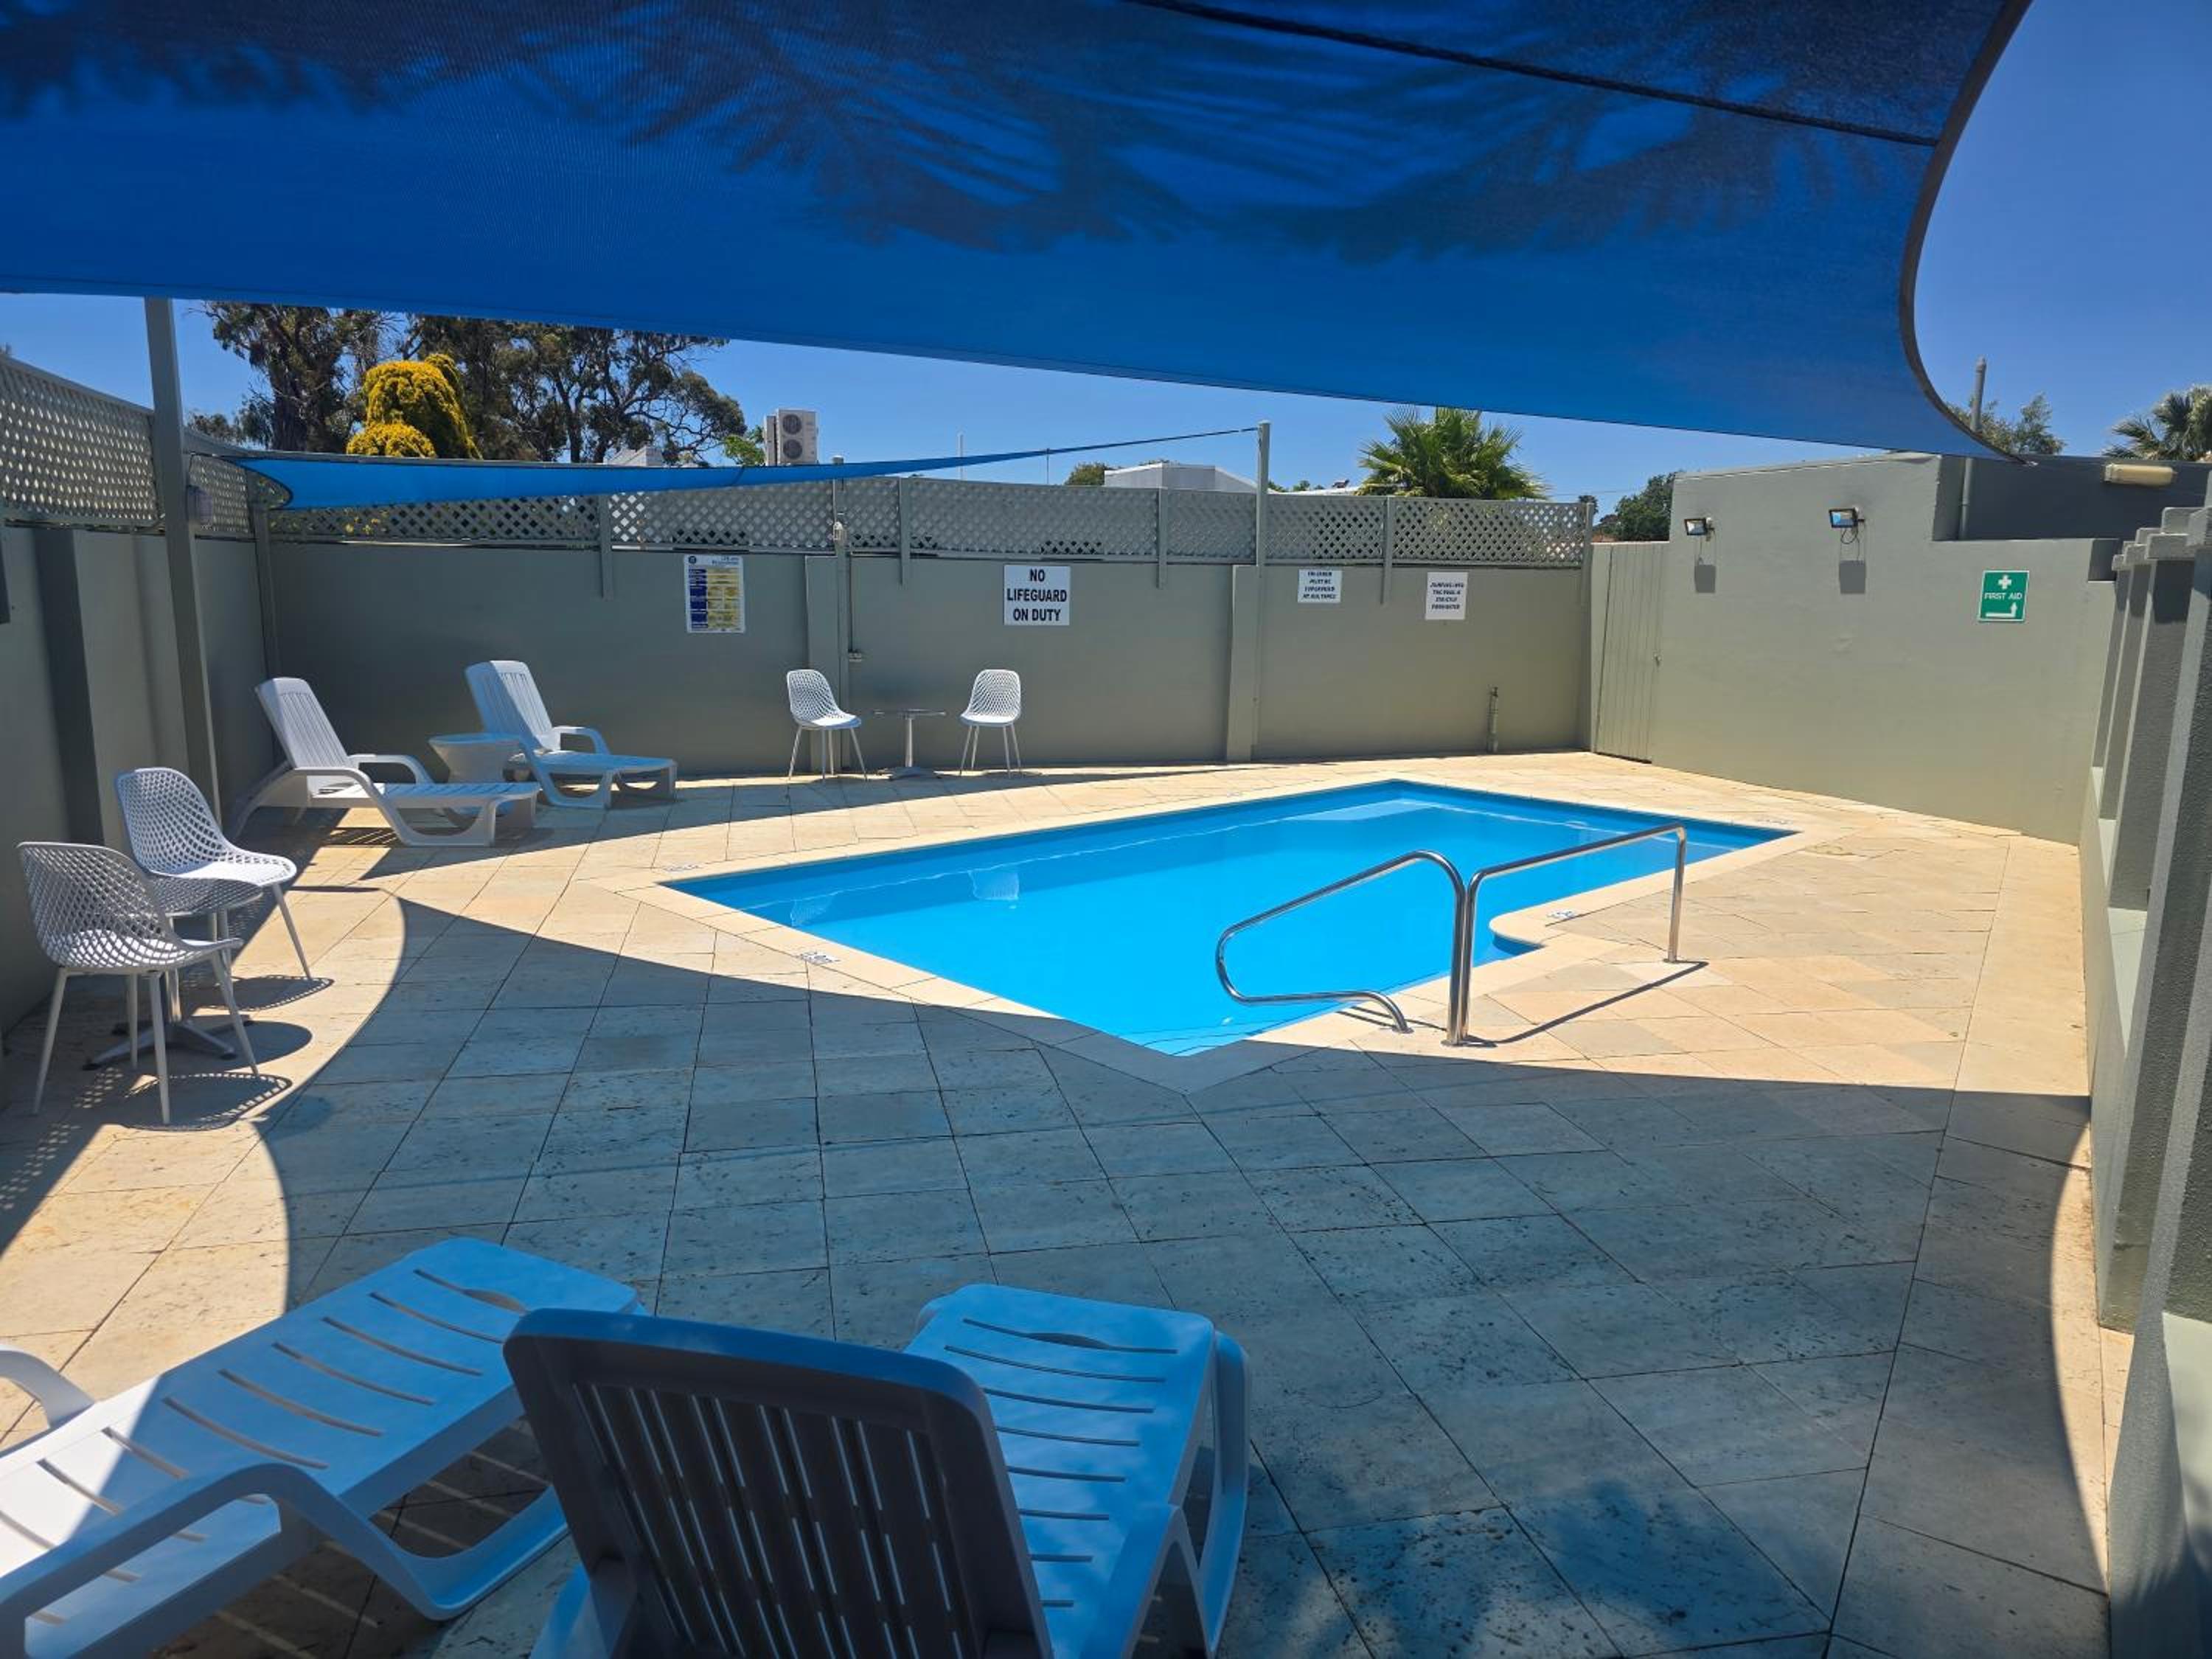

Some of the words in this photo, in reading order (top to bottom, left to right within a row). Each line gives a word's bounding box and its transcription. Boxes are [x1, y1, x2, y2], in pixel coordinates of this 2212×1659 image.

[1030, 568, 1046, 582] NO
[1007, 588, 1067, 602] LIFEGUARD
[1984, 592, 2006, 600] FIRST
[2008, 592, 2023, 600] AID
[1013, 608, 1028, 621] ON
[1032, 608, 1061, 622] DUTY
